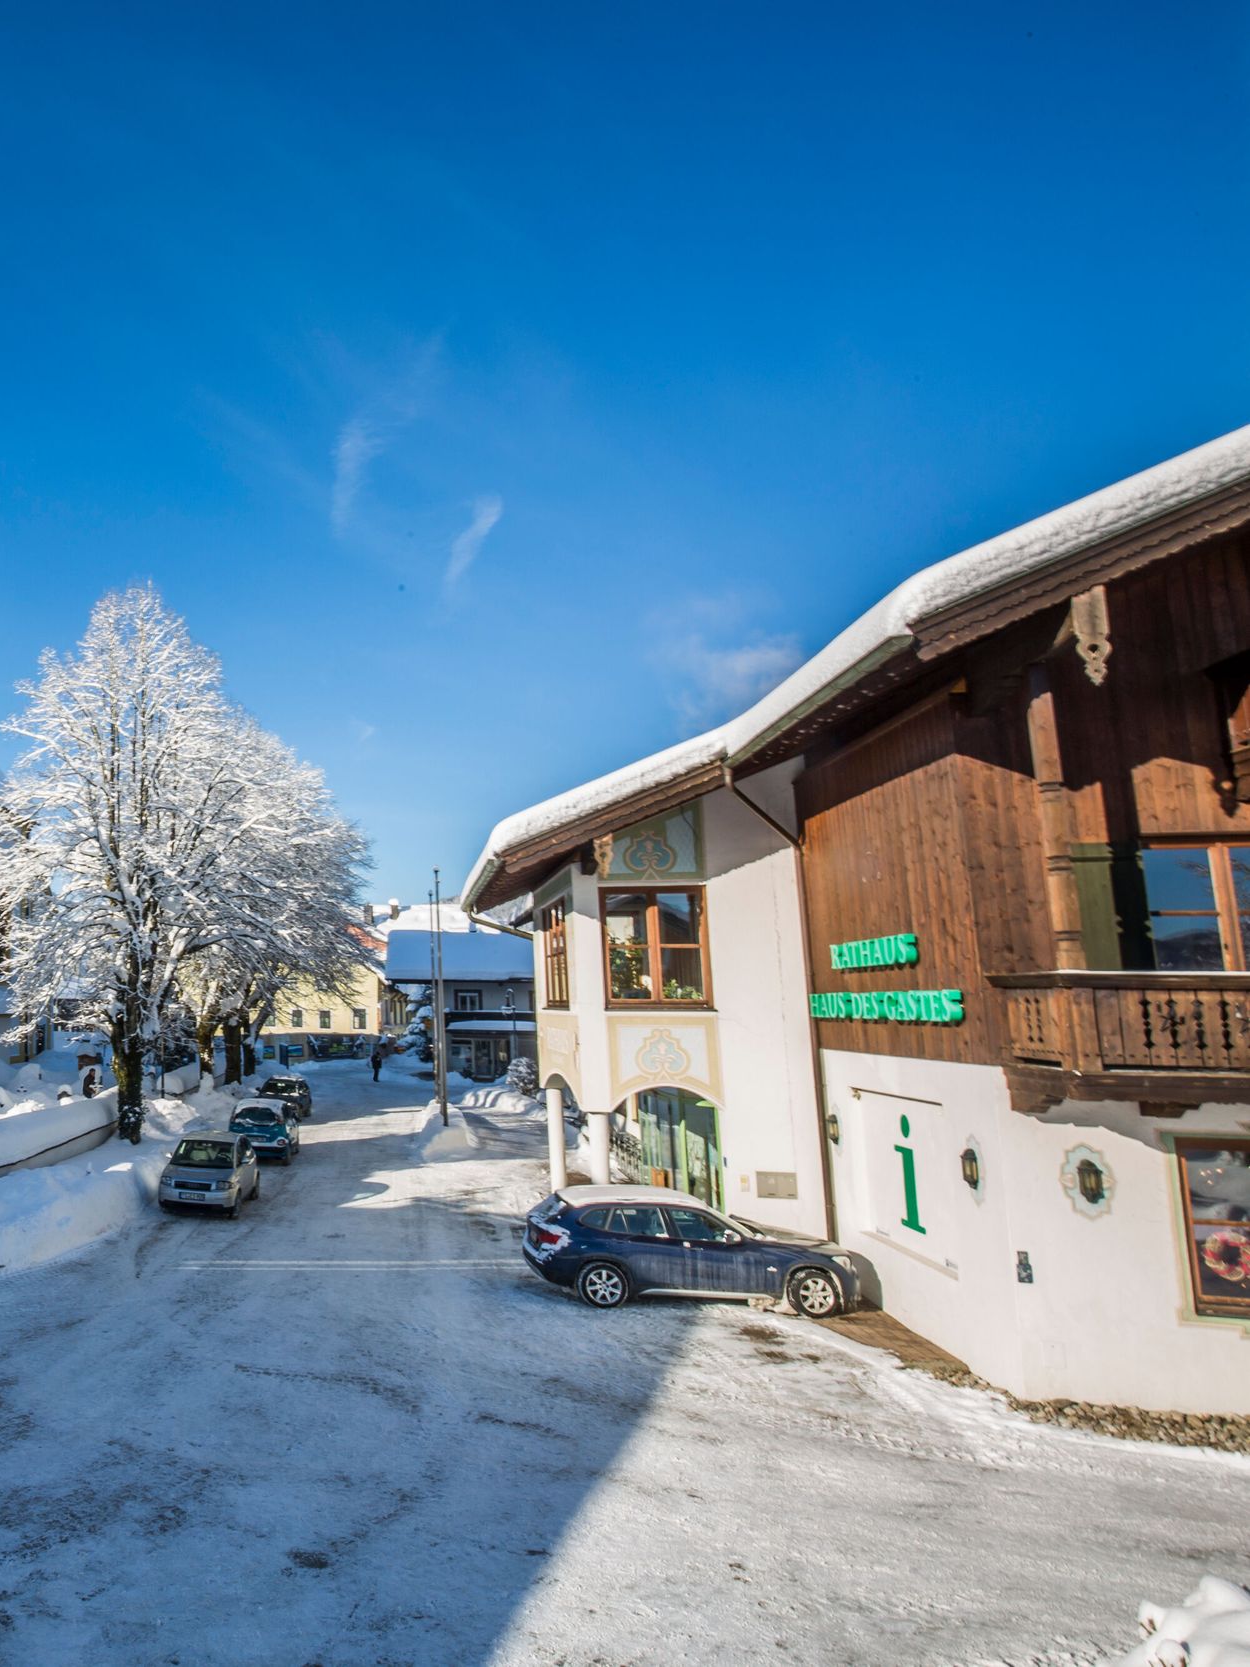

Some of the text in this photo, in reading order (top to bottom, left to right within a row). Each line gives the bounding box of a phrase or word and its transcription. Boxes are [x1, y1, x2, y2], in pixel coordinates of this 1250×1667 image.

[829, 933, 916, 969] RATHAUS
[809, 989, 960, 1022] HAUS DES GASTES
